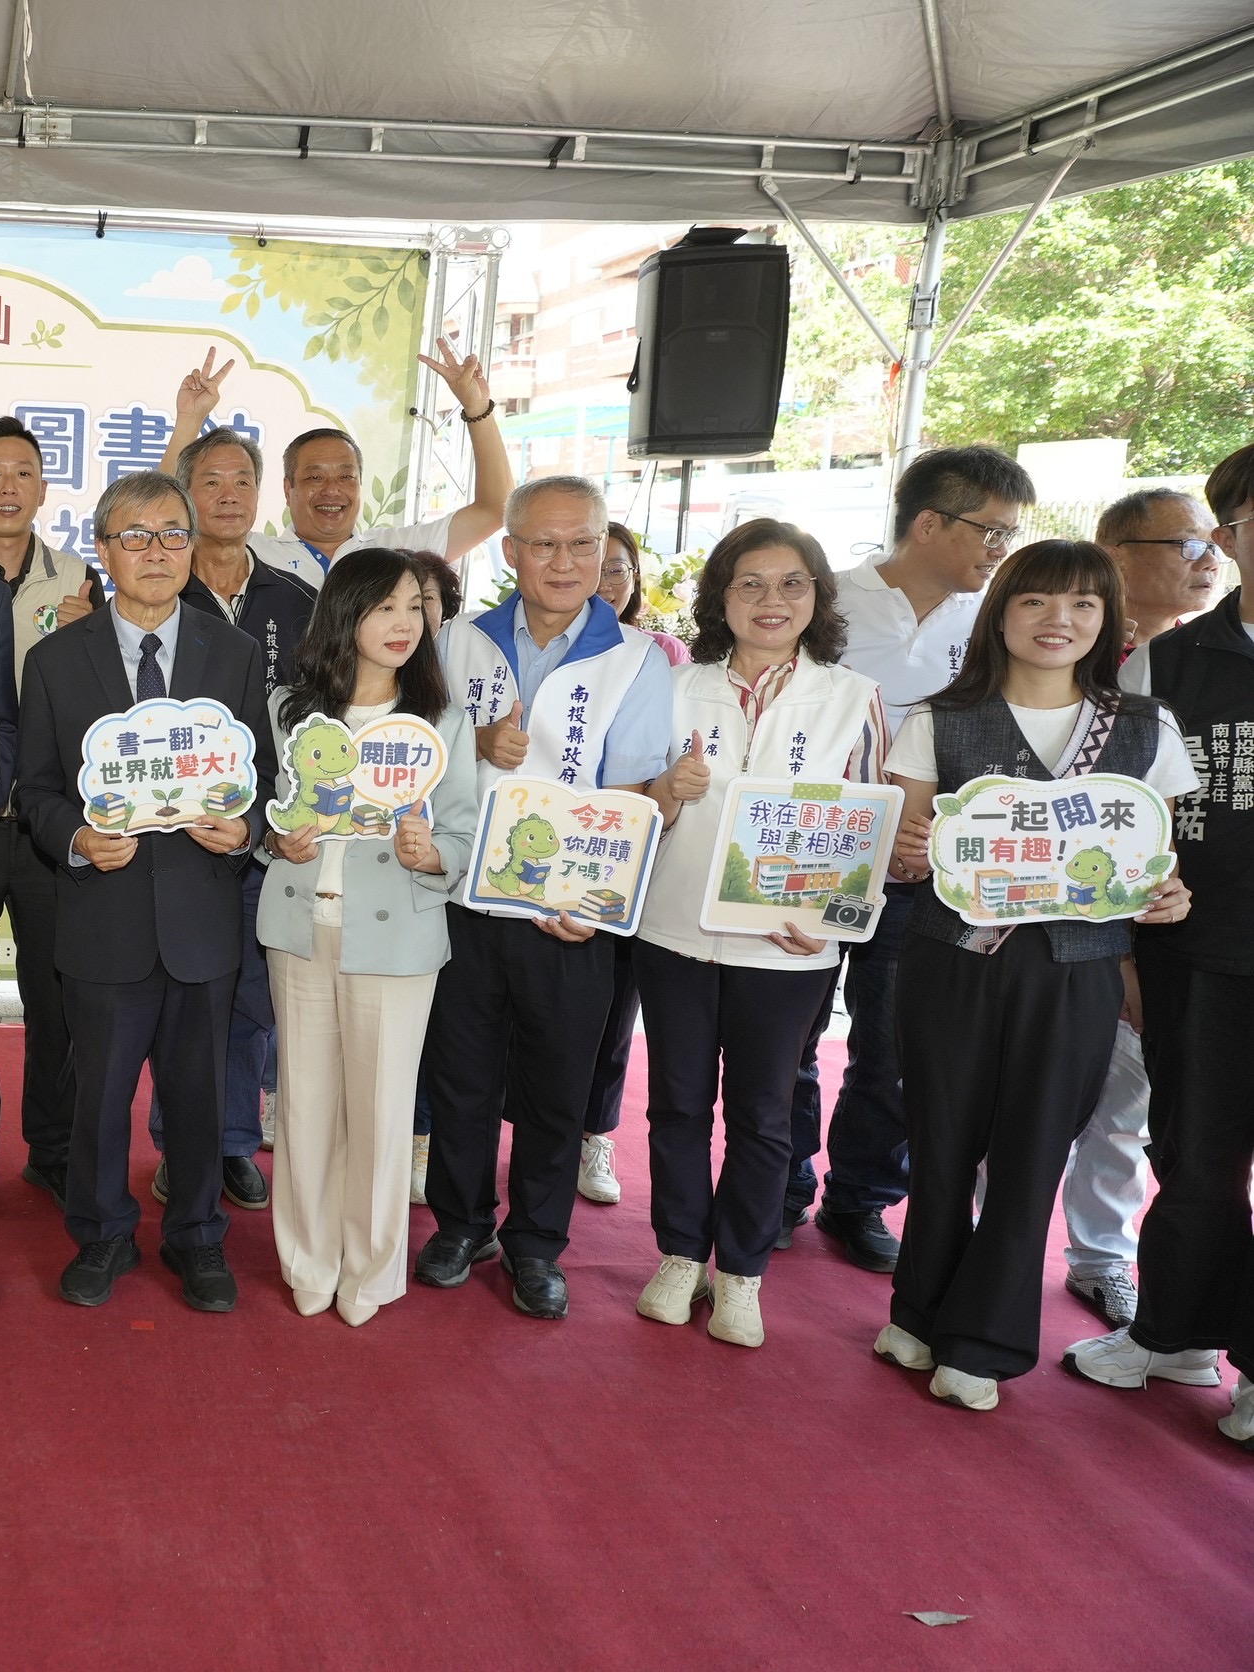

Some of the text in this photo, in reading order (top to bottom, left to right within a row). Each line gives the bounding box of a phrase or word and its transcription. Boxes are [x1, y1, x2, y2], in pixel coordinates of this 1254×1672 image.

[116, 727, 206, 757] 書一翻，
[558, 685, 589, 784] 南投縣政府
[703, 726, 720, 757] 主席
[100, 751, 237, 785] 世界就變大!
[361, 741, 432, 767] 閱讀力
[789, 731, 807, 776] 南投市
[1212, 723, 1230, 803] 南投市主任
[1232, 721, 1254, 810] 南投縣黨部
[373, 767, 416, 788] UP!
[570, 803, 623, 832] 今天
[749, 799, 874, 833] 我在圖書館
[971, 792, 1135, 832] 一起閱來
[562, 835, 632, 862] 你閱讀
[757, 828, 856, 857] 與書相遇
[956, 837, 1067, 863] 閱有趣!
[559, 859, 614, 881] 了嗎?
